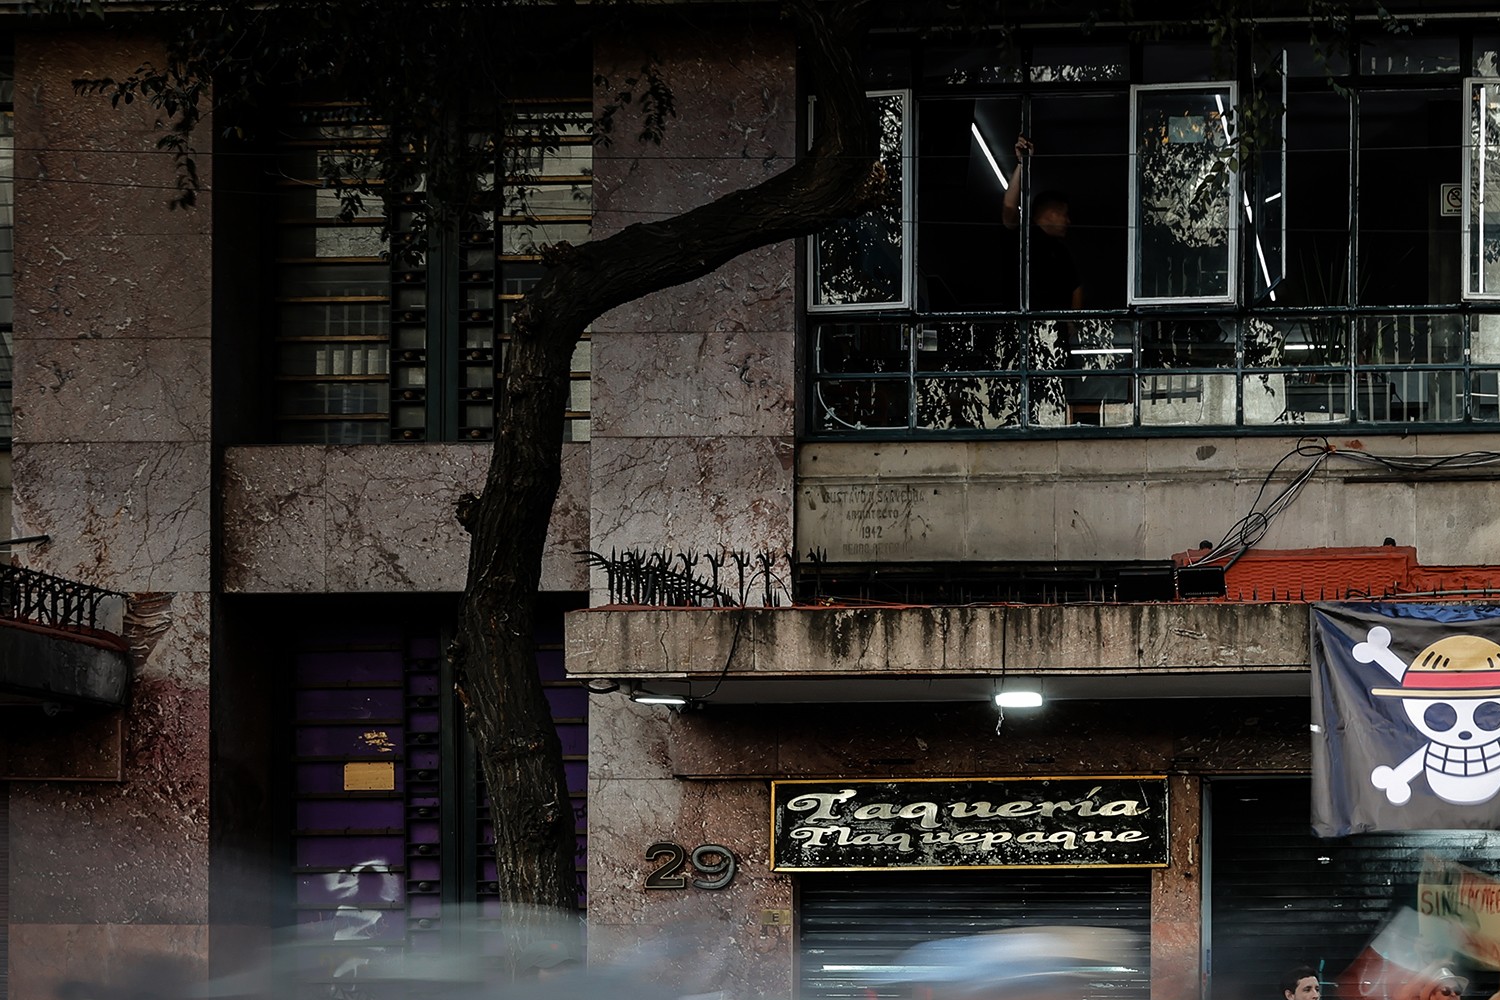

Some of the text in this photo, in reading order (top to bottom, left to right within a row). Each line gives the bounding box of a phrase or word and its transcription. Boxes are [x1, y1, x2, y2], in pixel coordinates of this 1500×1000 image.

[861, 525, 883, 539] 1942
[786, 785, 1151, 829] Taquería
[789, 824, 1151, 852] Tlaquepaque
[643, 841, 737, 889] 29
[772, 912, 780, 922] E
